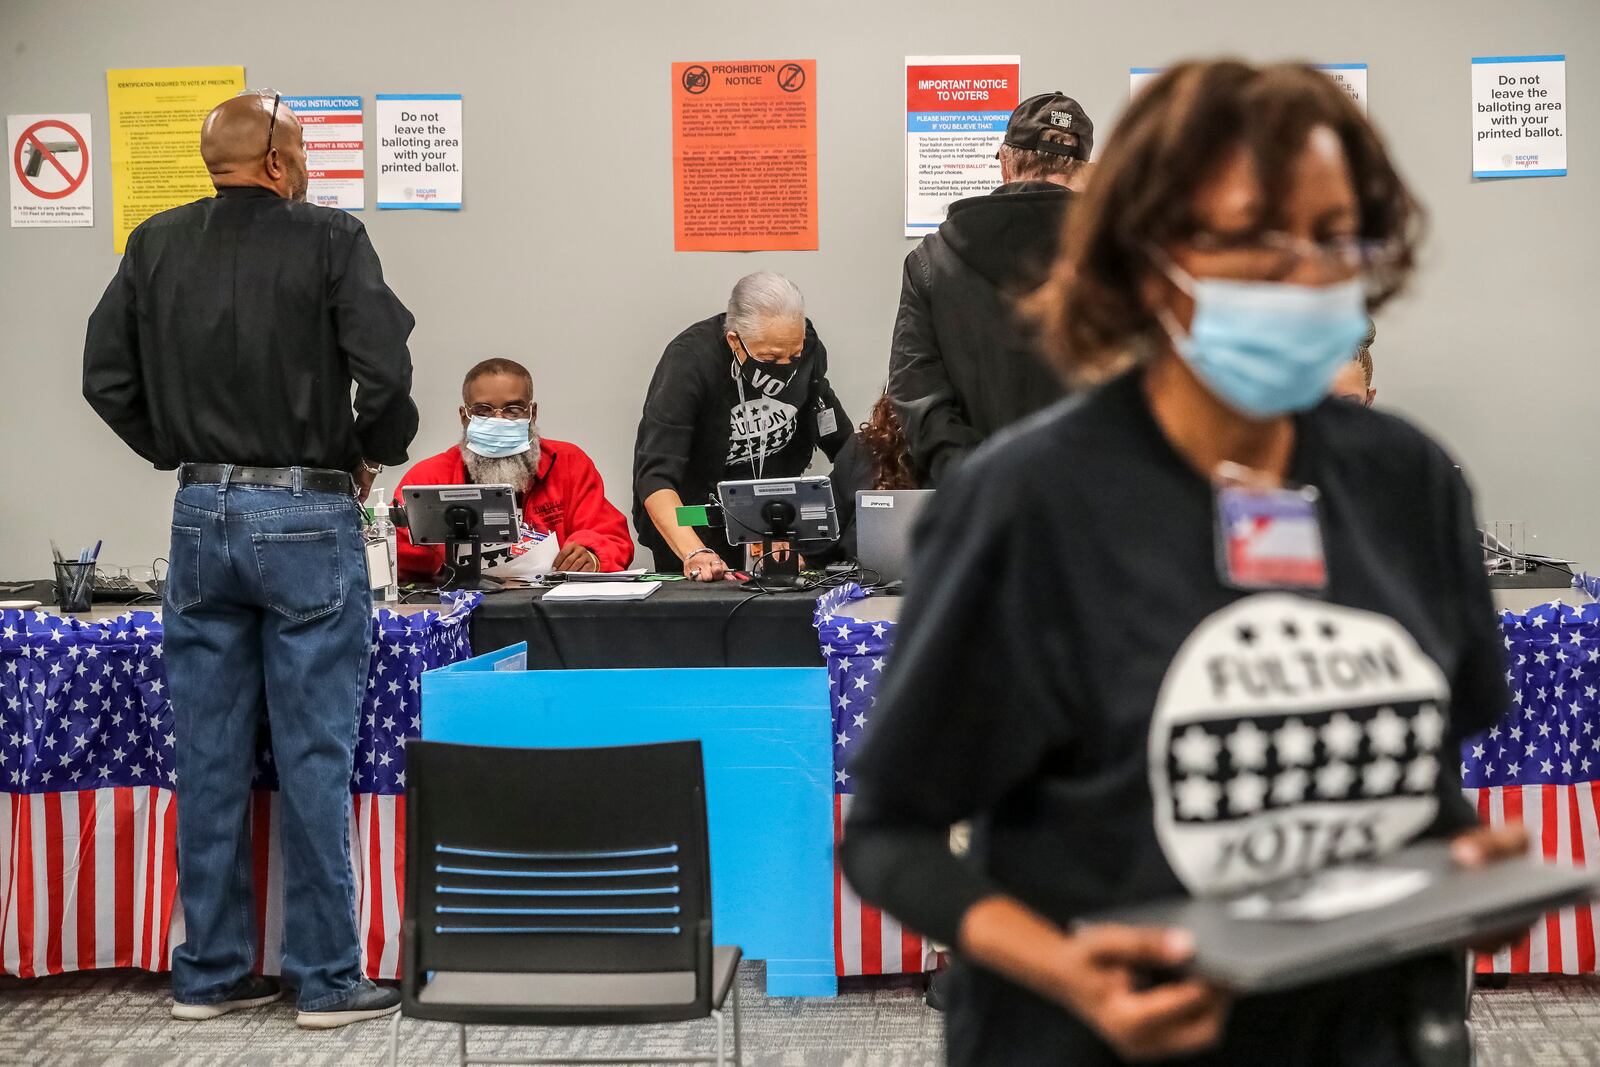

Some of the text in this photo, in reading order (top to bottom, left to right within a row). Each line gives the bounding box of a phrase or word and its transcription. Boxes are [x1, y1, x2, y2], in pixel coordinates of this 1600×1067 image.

[712, 65, 775, 74] PROHIBITION
[725, 76, 762, 85] NOTICE
[918, 80, 1008, 90] IMPORTANT NOTICE
[1499, 75, 1540, 85] Do not
[937, 91, 989, 100] TO VOTERS
[1492, 88, 1547, 99] leave the
[1478, 102, 1530, 113] balloting
[401, 112, 439, 121] Do not
[1491, 115, 1548, 126] with your
[395, 125, 446, 134] leave the
[1478, 127, 1562, 141] printed ballot.
[382, 138, 430, 148] balloting
[394, 150, 446, 161] with your
[382, 162, 459, 174] printed ballot.
[1205, 642, 1403, 700] FULTON
